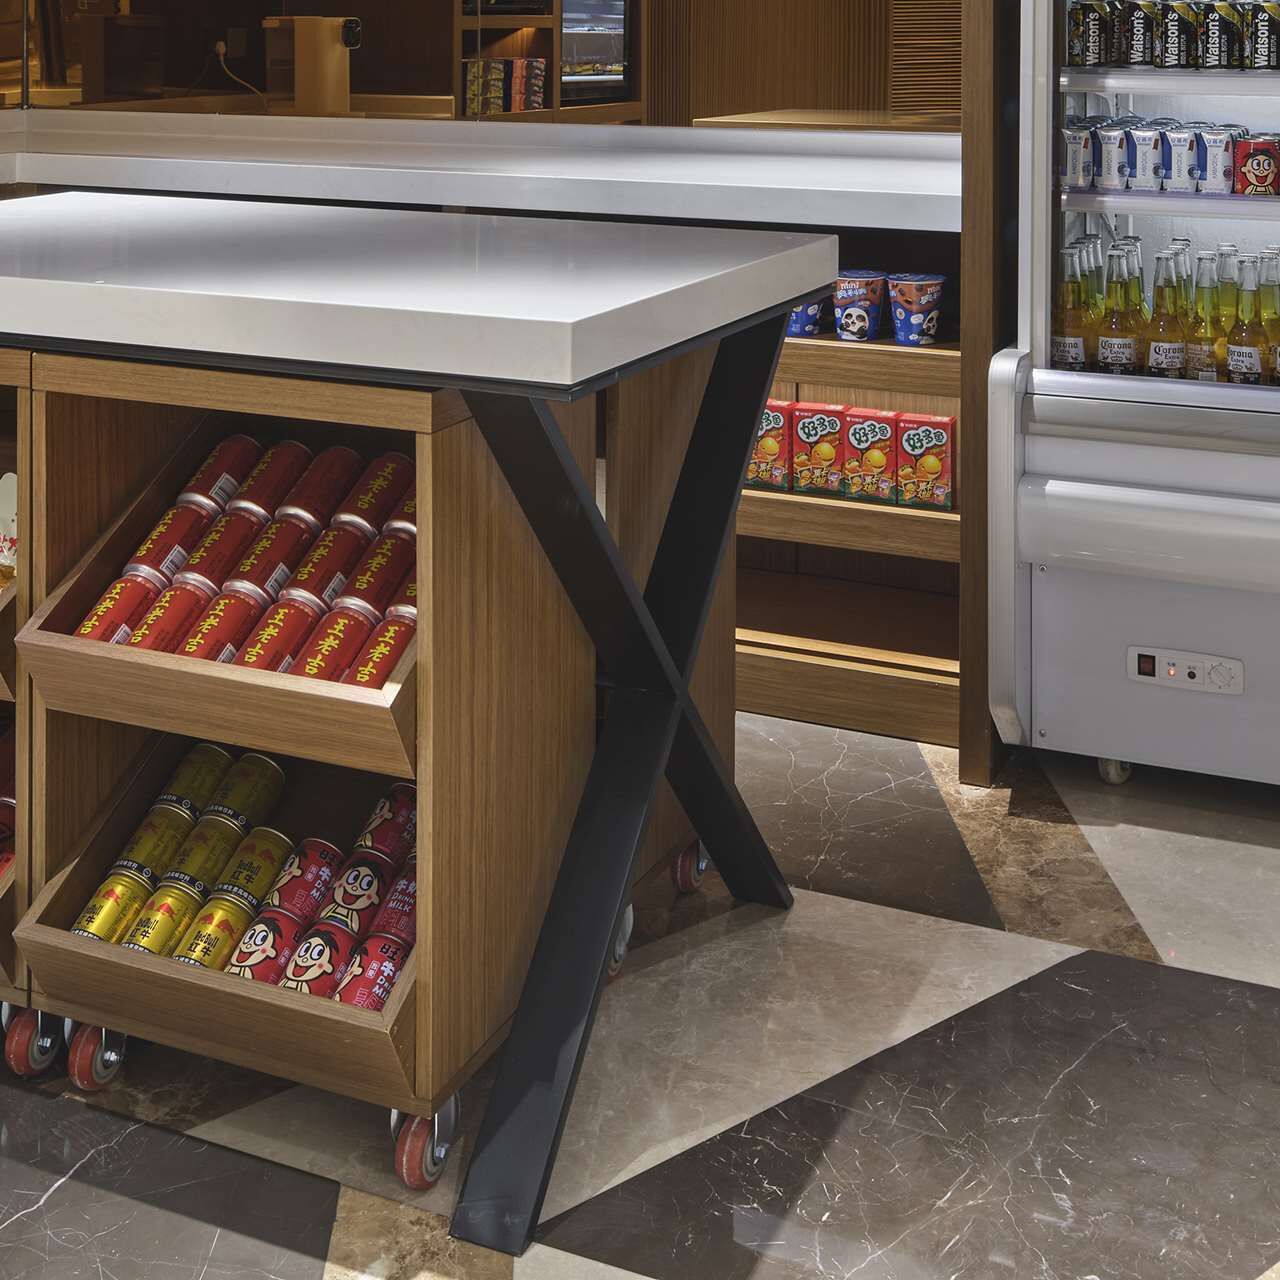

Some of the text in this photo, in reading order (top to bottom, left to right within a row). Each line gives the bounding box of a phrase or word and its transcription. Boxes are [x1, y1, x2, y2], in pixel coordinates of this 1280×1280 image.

[1086, 11, 1101, 66] Watson's
[1130, 10, 1145, 64] Watson's
[1164, 11, 1179, 67] Watson's
[1206, 11, 1220, 67] Watson's
[1255, 11, 1270, 69] Watson's
[840, 280, 859, 291] mini
[1100, 339, 1132, 350] Corona
[801, 415, 839, 440] 好多鱼
[852, 422, 889, 446] 好多鱼
[905, 427, 945, 452] 好多鱼
[189, 516, 227, 566] 王老吉
[240, 523, 280, 573] 王老吉
[297, 531, 338, 581] 王老吉
[355, 539, 395, 590] 王老吉
[79, 582, 126, 635] 王老吉
[131, 590, 175, 644] 王老吉
[185, 598, 230, 653] 王老吉
[244, 607, 289, 664] 王老吉
[305, 618, 350, 676] 王老吉
[357, 625, 400, 683] 王老吉
[389, 899, 412, 913] MILK
[185, 942, 213, 958] 红牛
